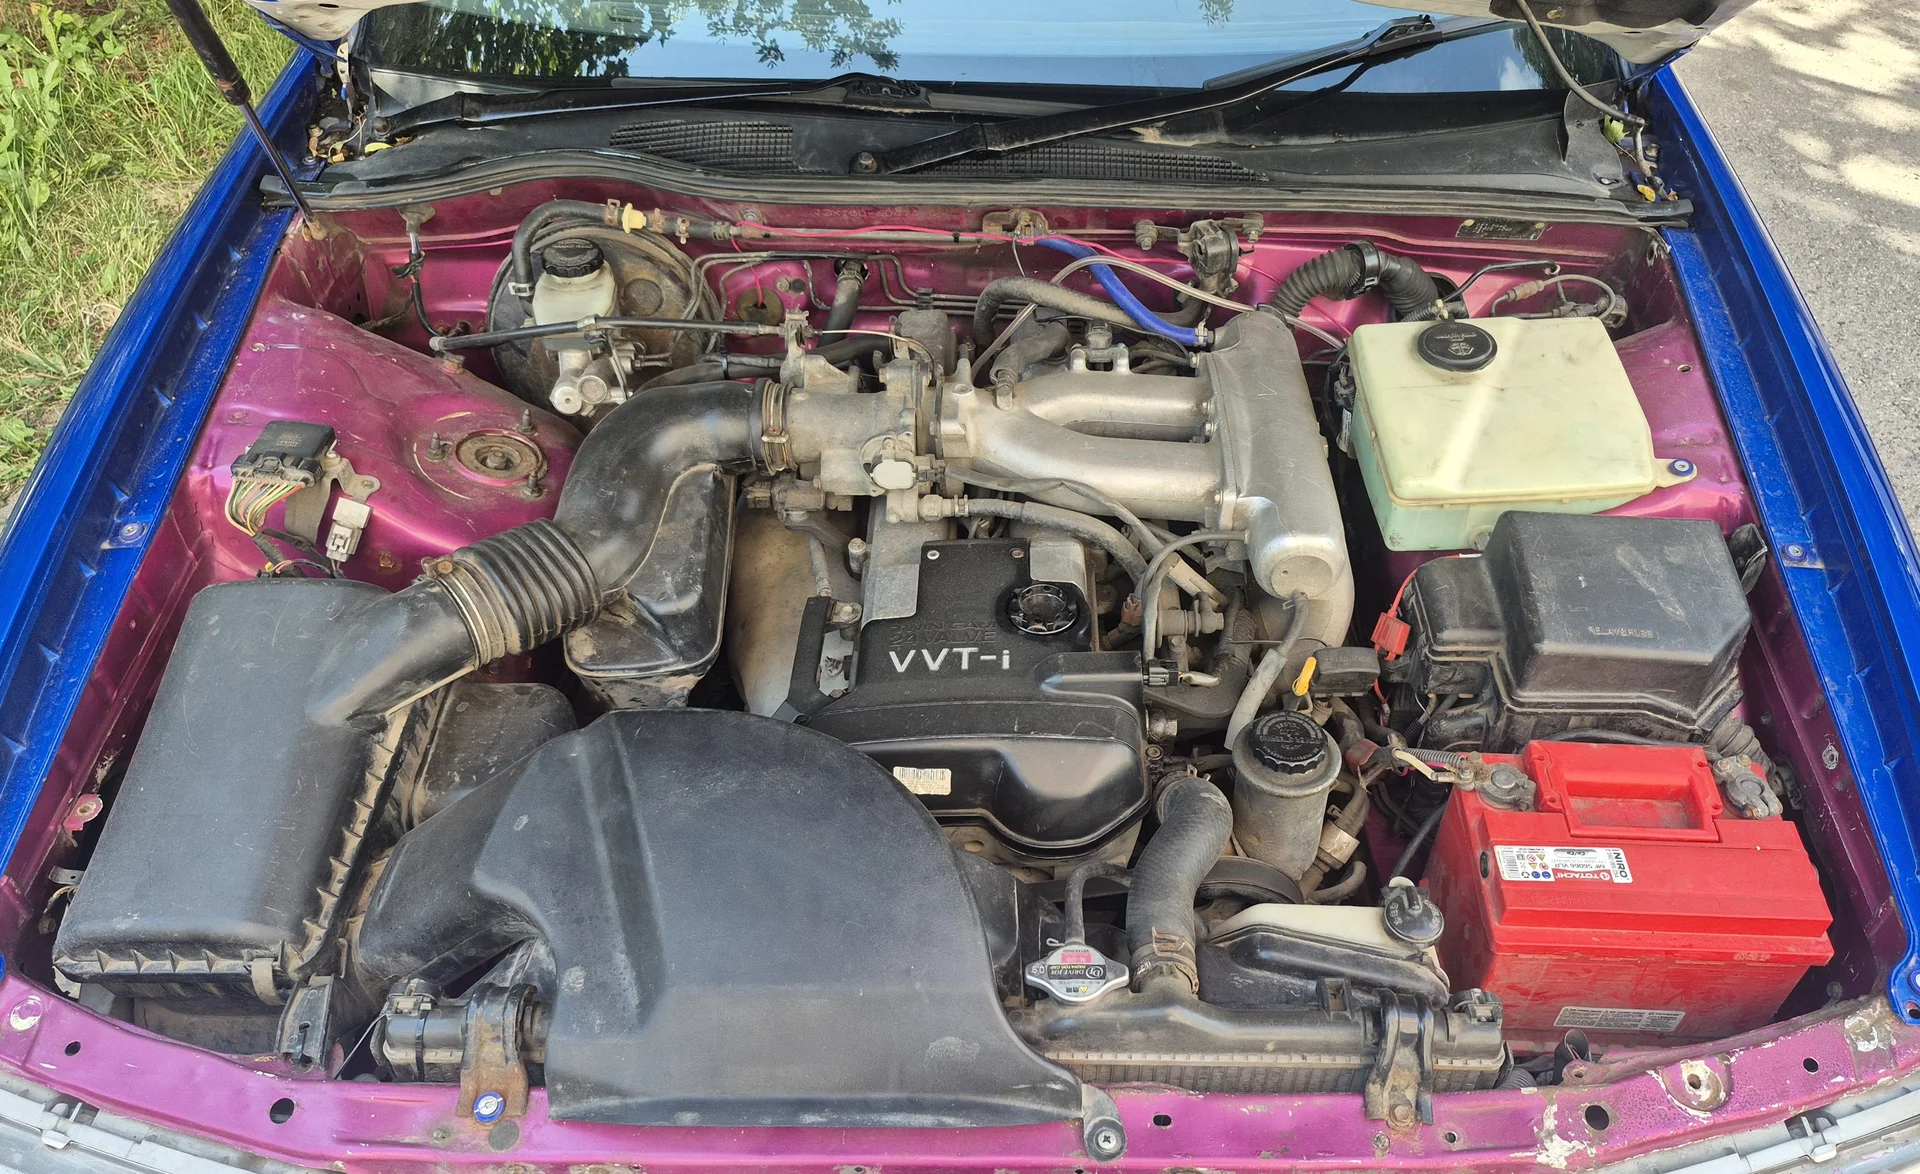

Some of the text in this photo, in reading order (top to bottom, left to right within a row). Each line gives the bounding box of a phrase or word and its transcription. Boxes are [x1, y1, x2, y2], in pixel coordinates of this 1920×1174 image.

[925, 630, 997, 645] VALVE
[888, 647, 1010, 672] VVT-i
[1613, 852, 1628, 878] NIRO
[1556, 871, 1600, 879] TOTACHI
[1031, 965, 1045, 974] 0.9
